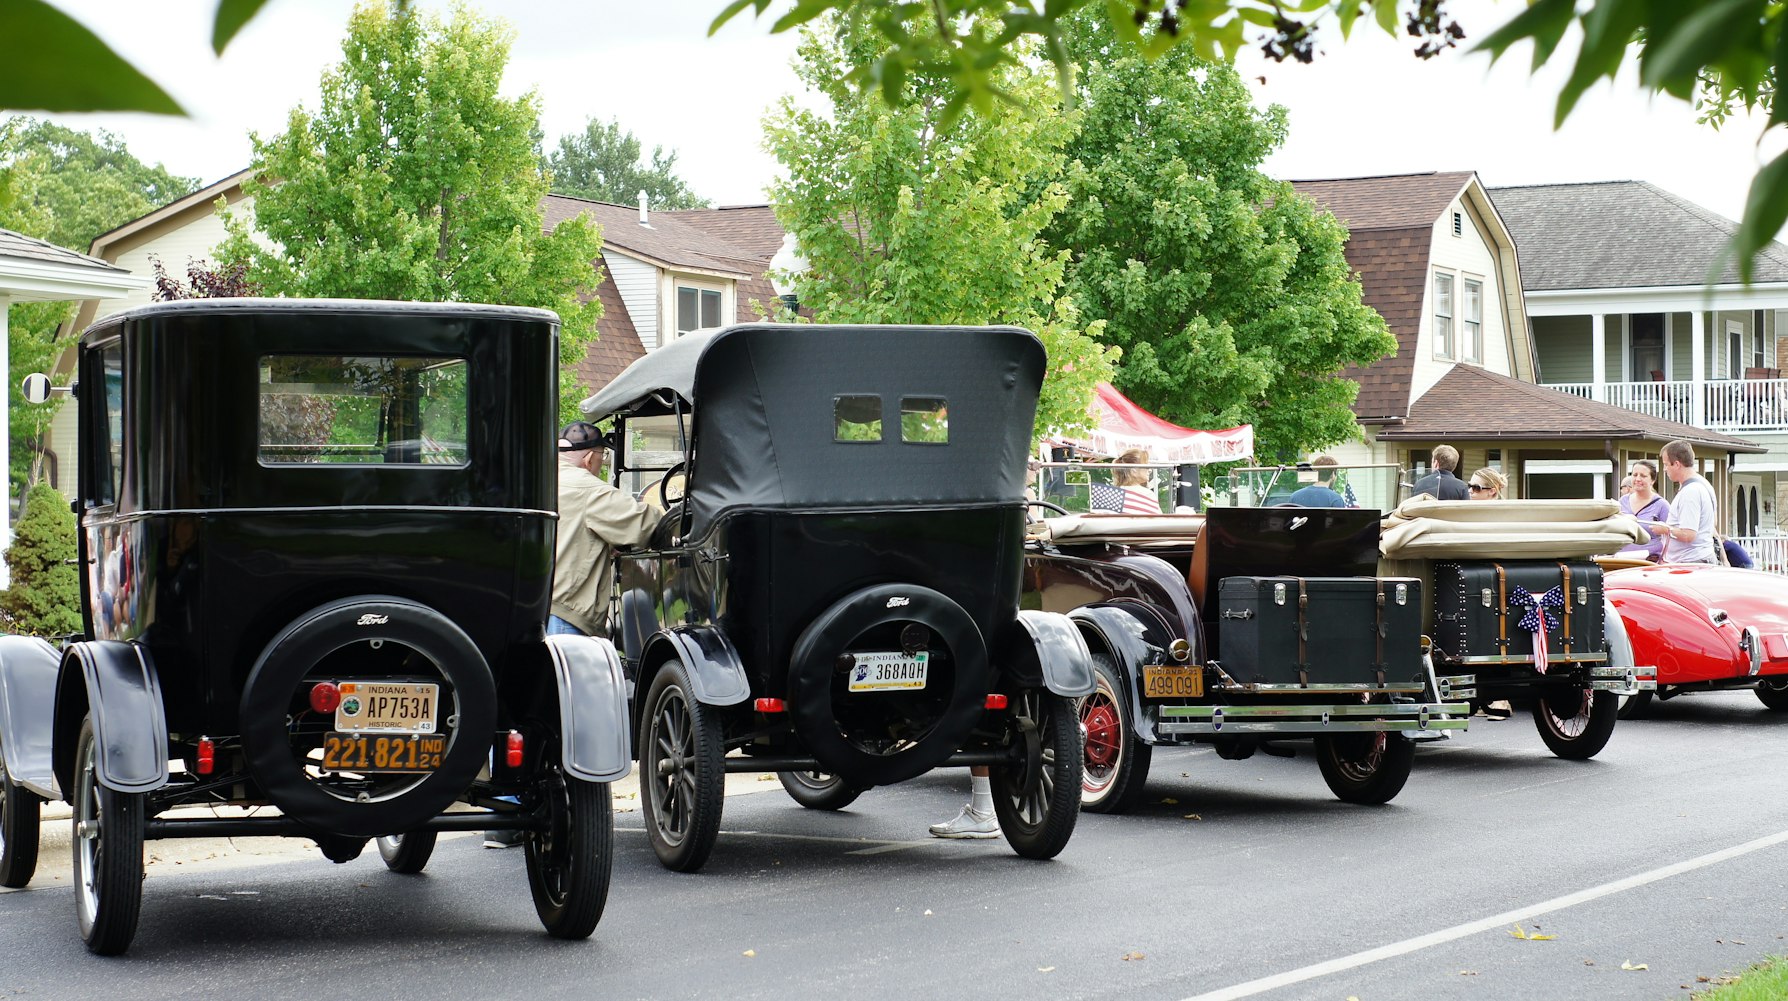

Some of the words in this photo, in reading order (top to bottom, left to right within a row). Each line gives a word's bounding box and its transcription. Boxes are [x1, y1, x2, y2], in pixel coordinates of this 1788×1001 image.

[886, 597, 910, 608] Ford
[357, 613, 389, 626] Ford
[876, 662, 925, 680] 368AQH
[368, 686, 408, 694] INDIANA
[1149, 676, 1173, 695] 499
[1176, 676, 1199, 695] 091
[367, 697, 430, 719] AP753A
[420, 722, 431, 730] 43
[420, 739, 442, 753] IND
[419, 754, 441, 768] 24
